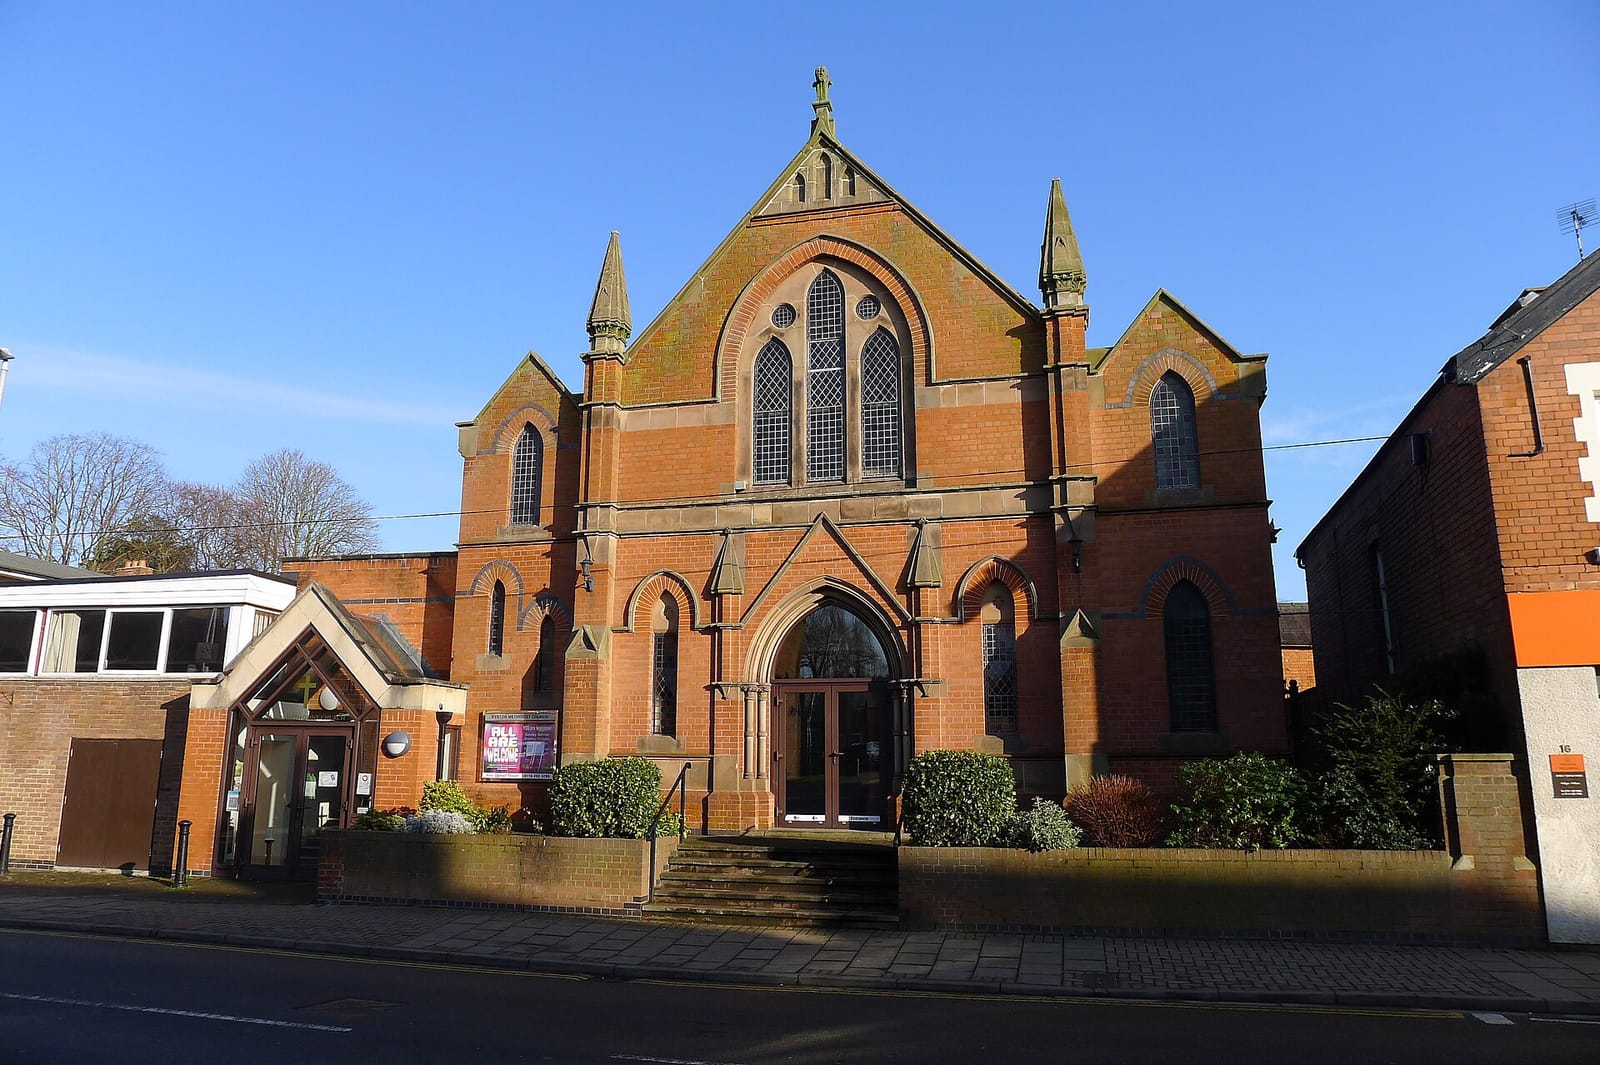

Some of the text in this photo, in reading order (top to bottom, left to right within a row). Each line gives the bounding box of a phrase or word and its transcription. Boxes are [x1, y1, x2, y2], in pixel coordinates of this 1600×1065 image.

[491, 727, 516, 737] ALL
[488, 737, 518, 746] ARE
[1559, 744, 1572, 753] 16
[487, 747, 518, 762] WELCOME
